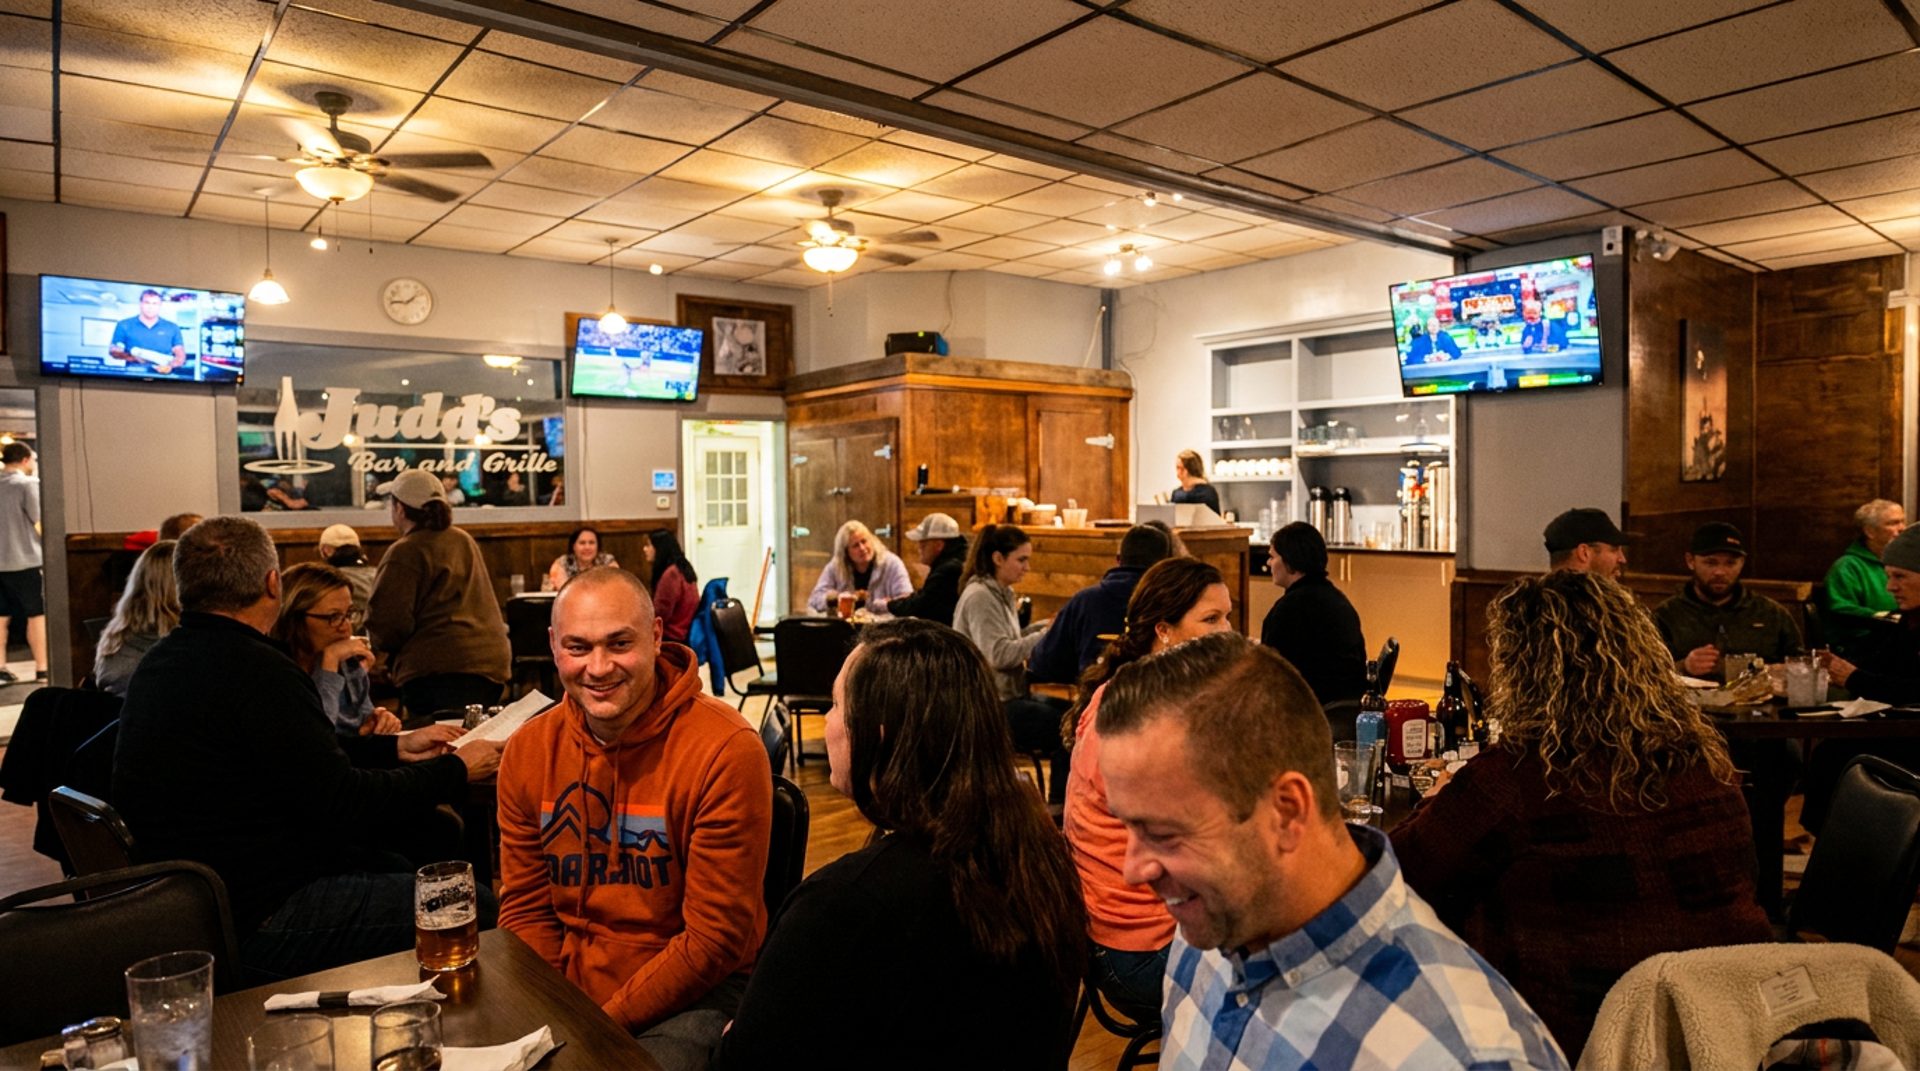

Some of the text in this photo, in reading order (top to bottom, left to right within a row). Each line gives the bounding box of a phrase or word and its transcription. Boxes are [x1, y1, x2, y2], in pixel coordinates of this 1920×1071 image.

[299, 387, 522, 450] Judd's
[348, 451, 558, 474] Bar and Grille
